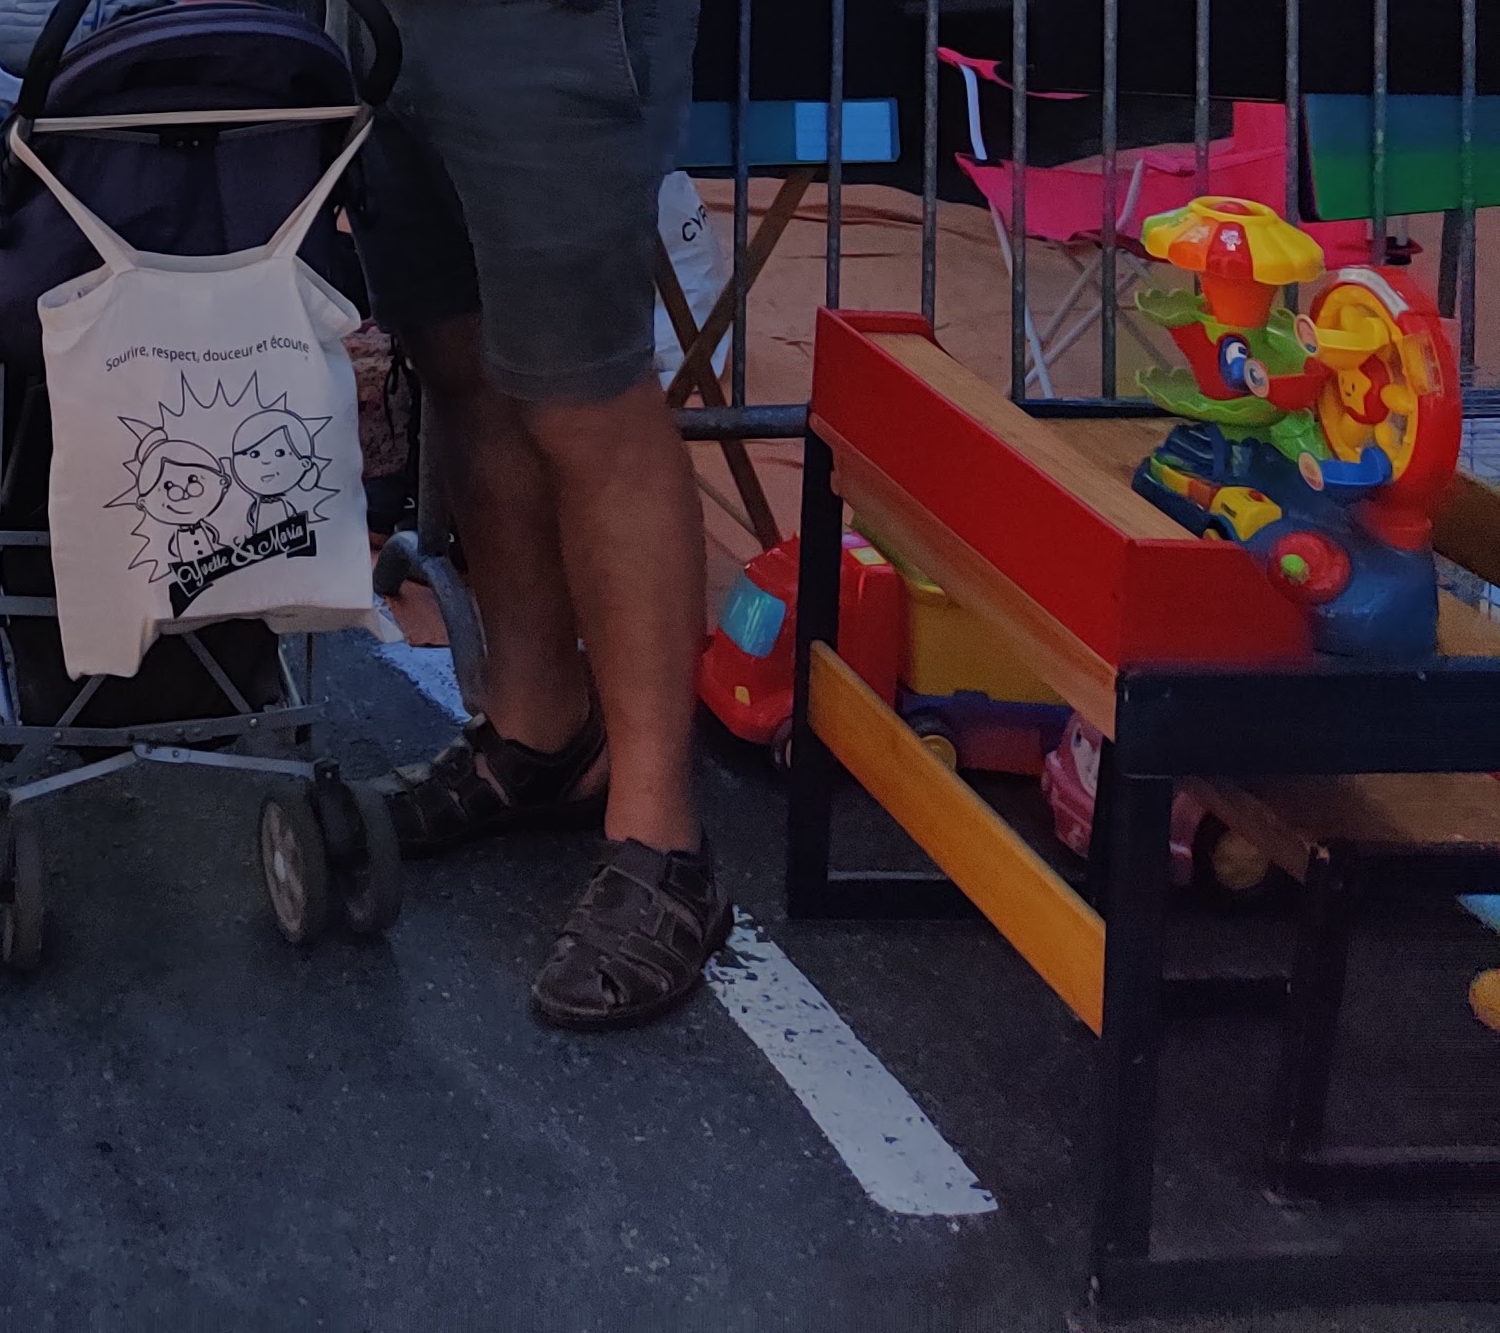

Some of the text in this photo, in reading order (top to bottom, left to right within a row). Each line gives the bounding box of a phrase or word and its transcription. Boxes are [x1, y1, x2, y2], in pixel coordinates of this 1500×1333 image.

[105, 334, 310, 372] Sourire, respect, douceur et écoute
[230, 535, 263, 567] &
[258, 523, 304, 555] Maria
